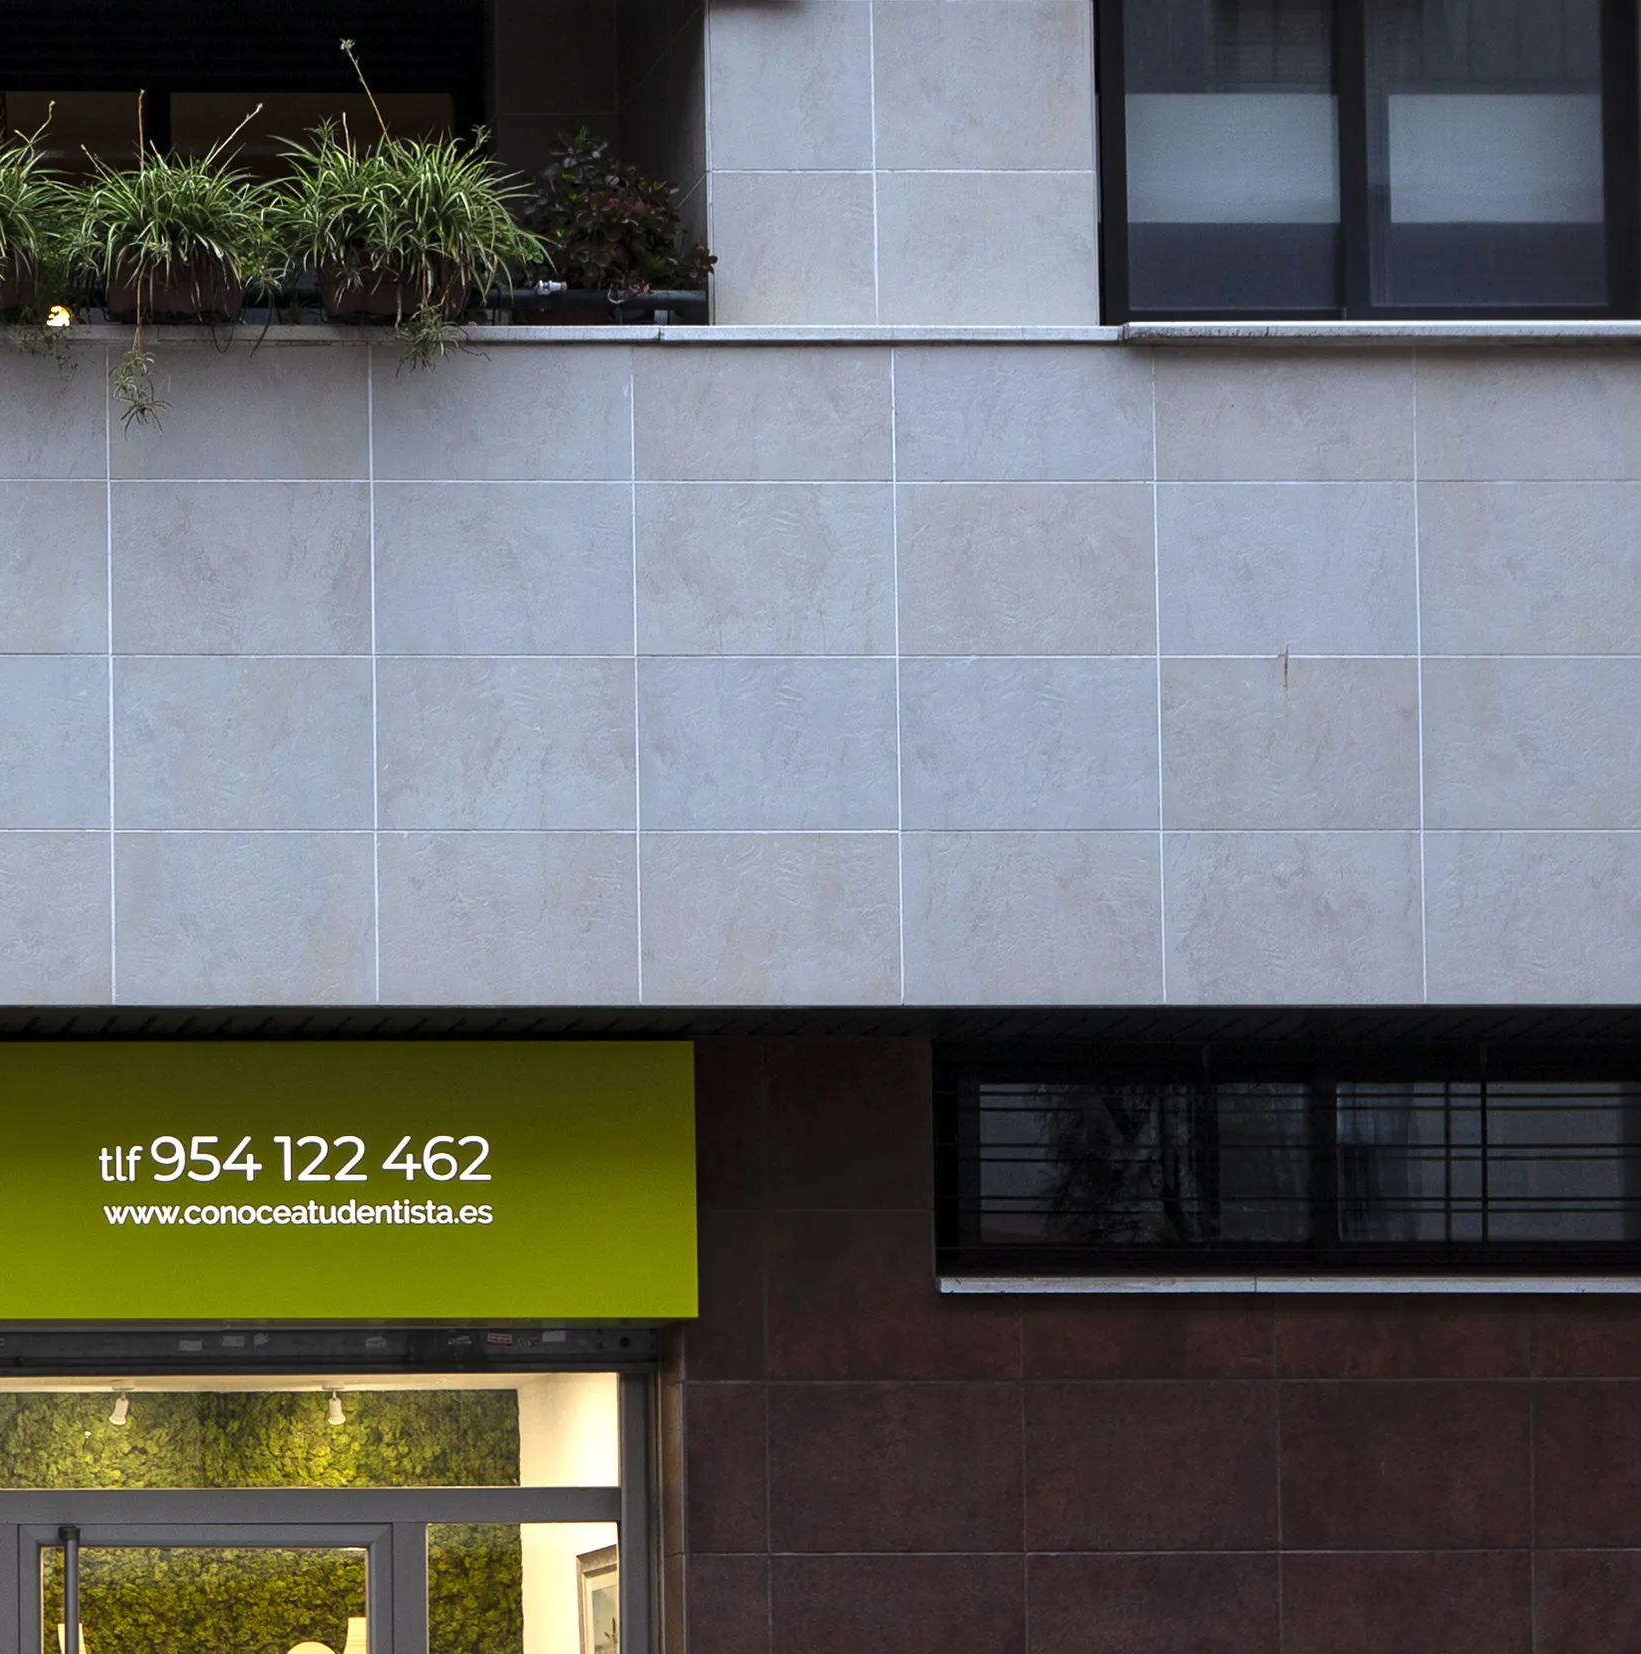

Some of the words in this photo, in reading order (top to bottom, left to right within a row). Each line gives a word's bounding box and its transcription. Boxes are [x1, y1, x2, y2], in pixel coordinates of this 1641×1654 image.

[99, 1145, 142, 1182] tlf
[150, 1136, 263, 1182] 954
[274, 1136, 368, 1182] 122
[383, 1136, 493, 1182] 462
[104, 1199, 494, 1226] www.conoceatudentista.es
